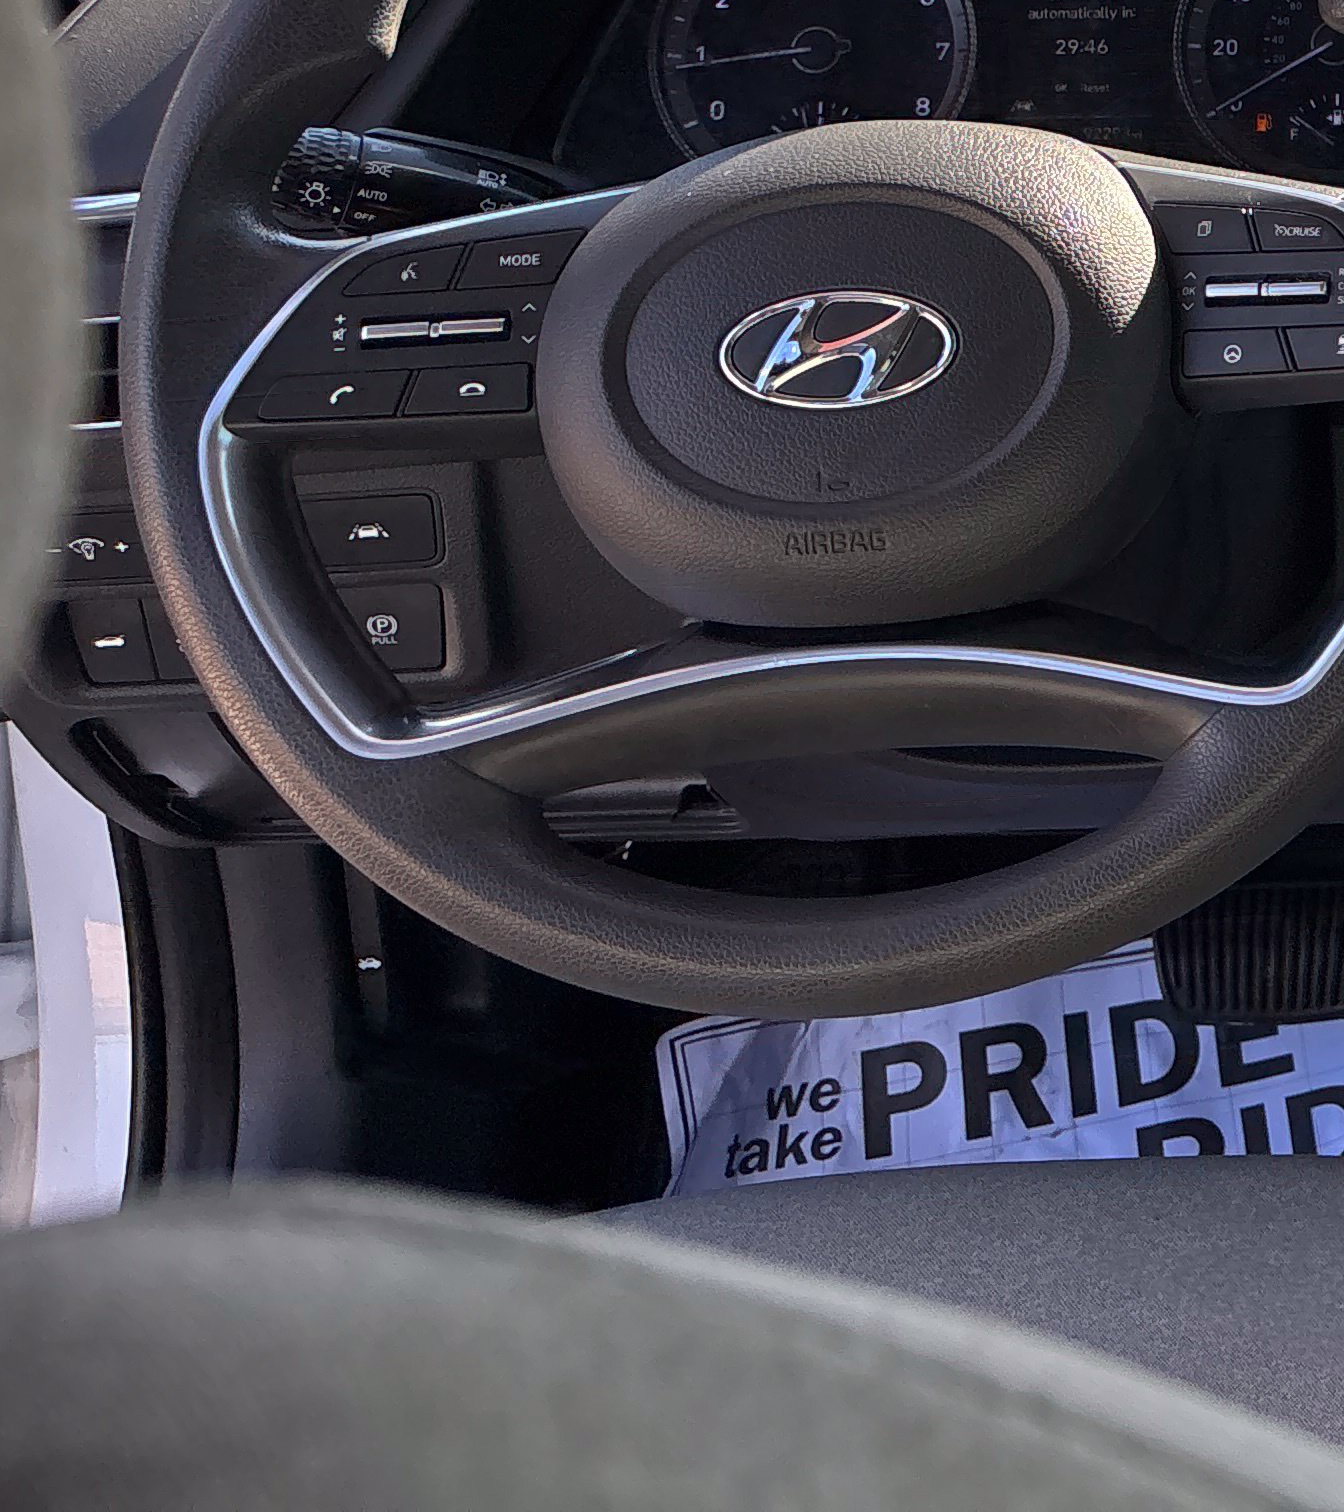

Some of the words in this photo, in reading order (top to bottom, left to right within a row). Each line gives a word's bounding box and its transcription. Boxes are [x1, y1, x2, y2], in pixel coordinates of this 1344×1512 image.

[1027, 5, 1118, 21] automatically
[935, 42, 950, 61] 7
[1055, 39, 1109, 56] 29:46
[1212, 39, 1239, 57] 20
[709, 100, 725, 121] 0
[915, 97, 931, 116] 8
[475, 178, 499, 189] AUTO
[357, 188, 388, 202] AUTO
[353, 211, 376, 222] OFF
[1286, 226, 1322, 237] CRUISE
[499, 253, 541, 267] MODE
[1182, 285, 1196, 296] OK
[784, 528, 888, 556] AIRBAG
[371, 636, 398, 645] PULL
[859, 998, 1295, 1160] PRIDE
[765, 1076, 842, 1121] we
[723, 1123, 843, 1180] take
